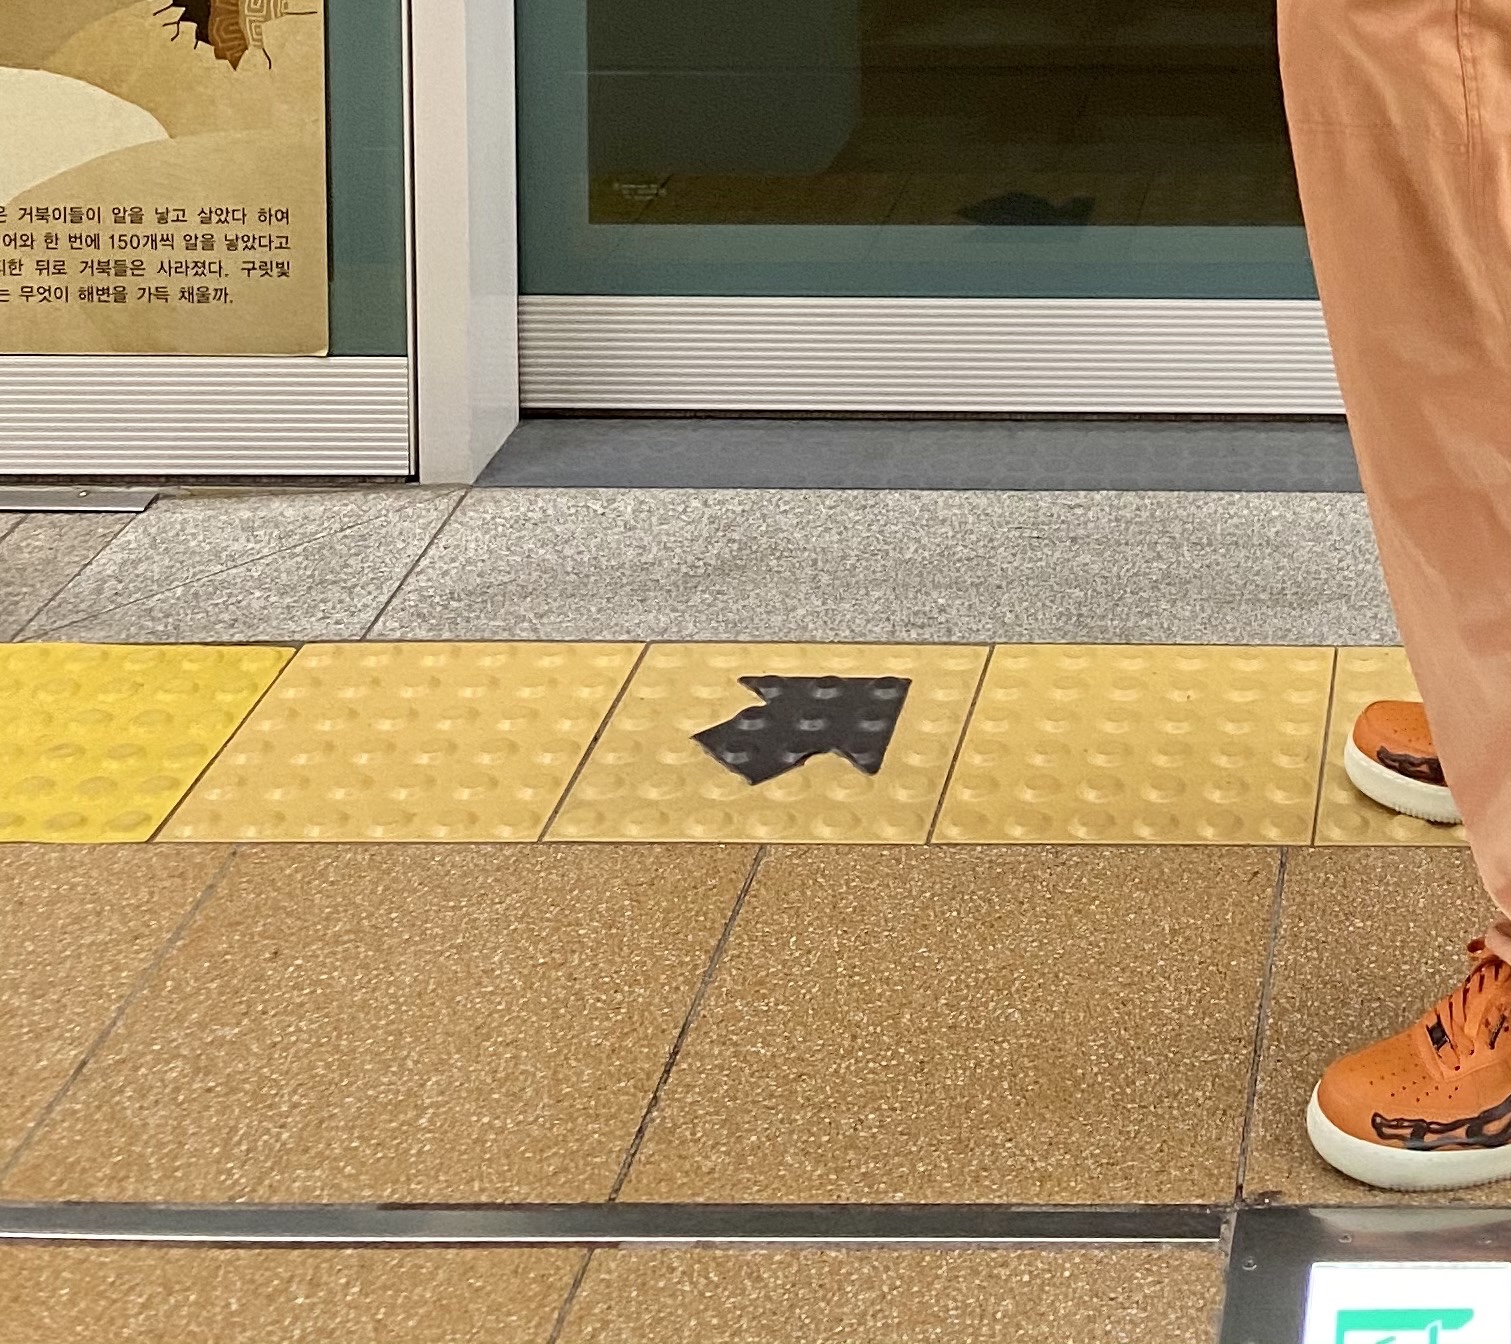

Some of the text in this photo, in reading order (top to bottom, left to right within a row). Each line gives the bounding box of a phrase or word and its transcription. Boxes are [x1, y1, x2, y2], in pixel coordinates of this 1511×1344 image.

[18, 206, 102, 225] 거북이들이
[112, 207, 145, 225] 알을
[154, 207, 188, 224] 낳고
[197, 207, 247, 225] 살았다
[257, 206, 290, 225] 하여
[44, 233, 60, 251] 한
[68, 233, 101, 251] 번에
[108, 233, 175, 251] 150개씩
[183, 234, 216, 251] 알을
[224, 234, 292, 252] 낳았다고
[34, 259, 68, 277] 뒤로
[79, 259, 146, 278] 거북들은
[156, 260, 229, 279] 사라졌다.
[240, 260, 291, 278] 구릿빛
[19, 286, 70, 304] 무엇이
[78, 286, 128, 304] 해변을
[136, 286, 170, 304] 가득
[178, 286, 234, 305] 채울까.
